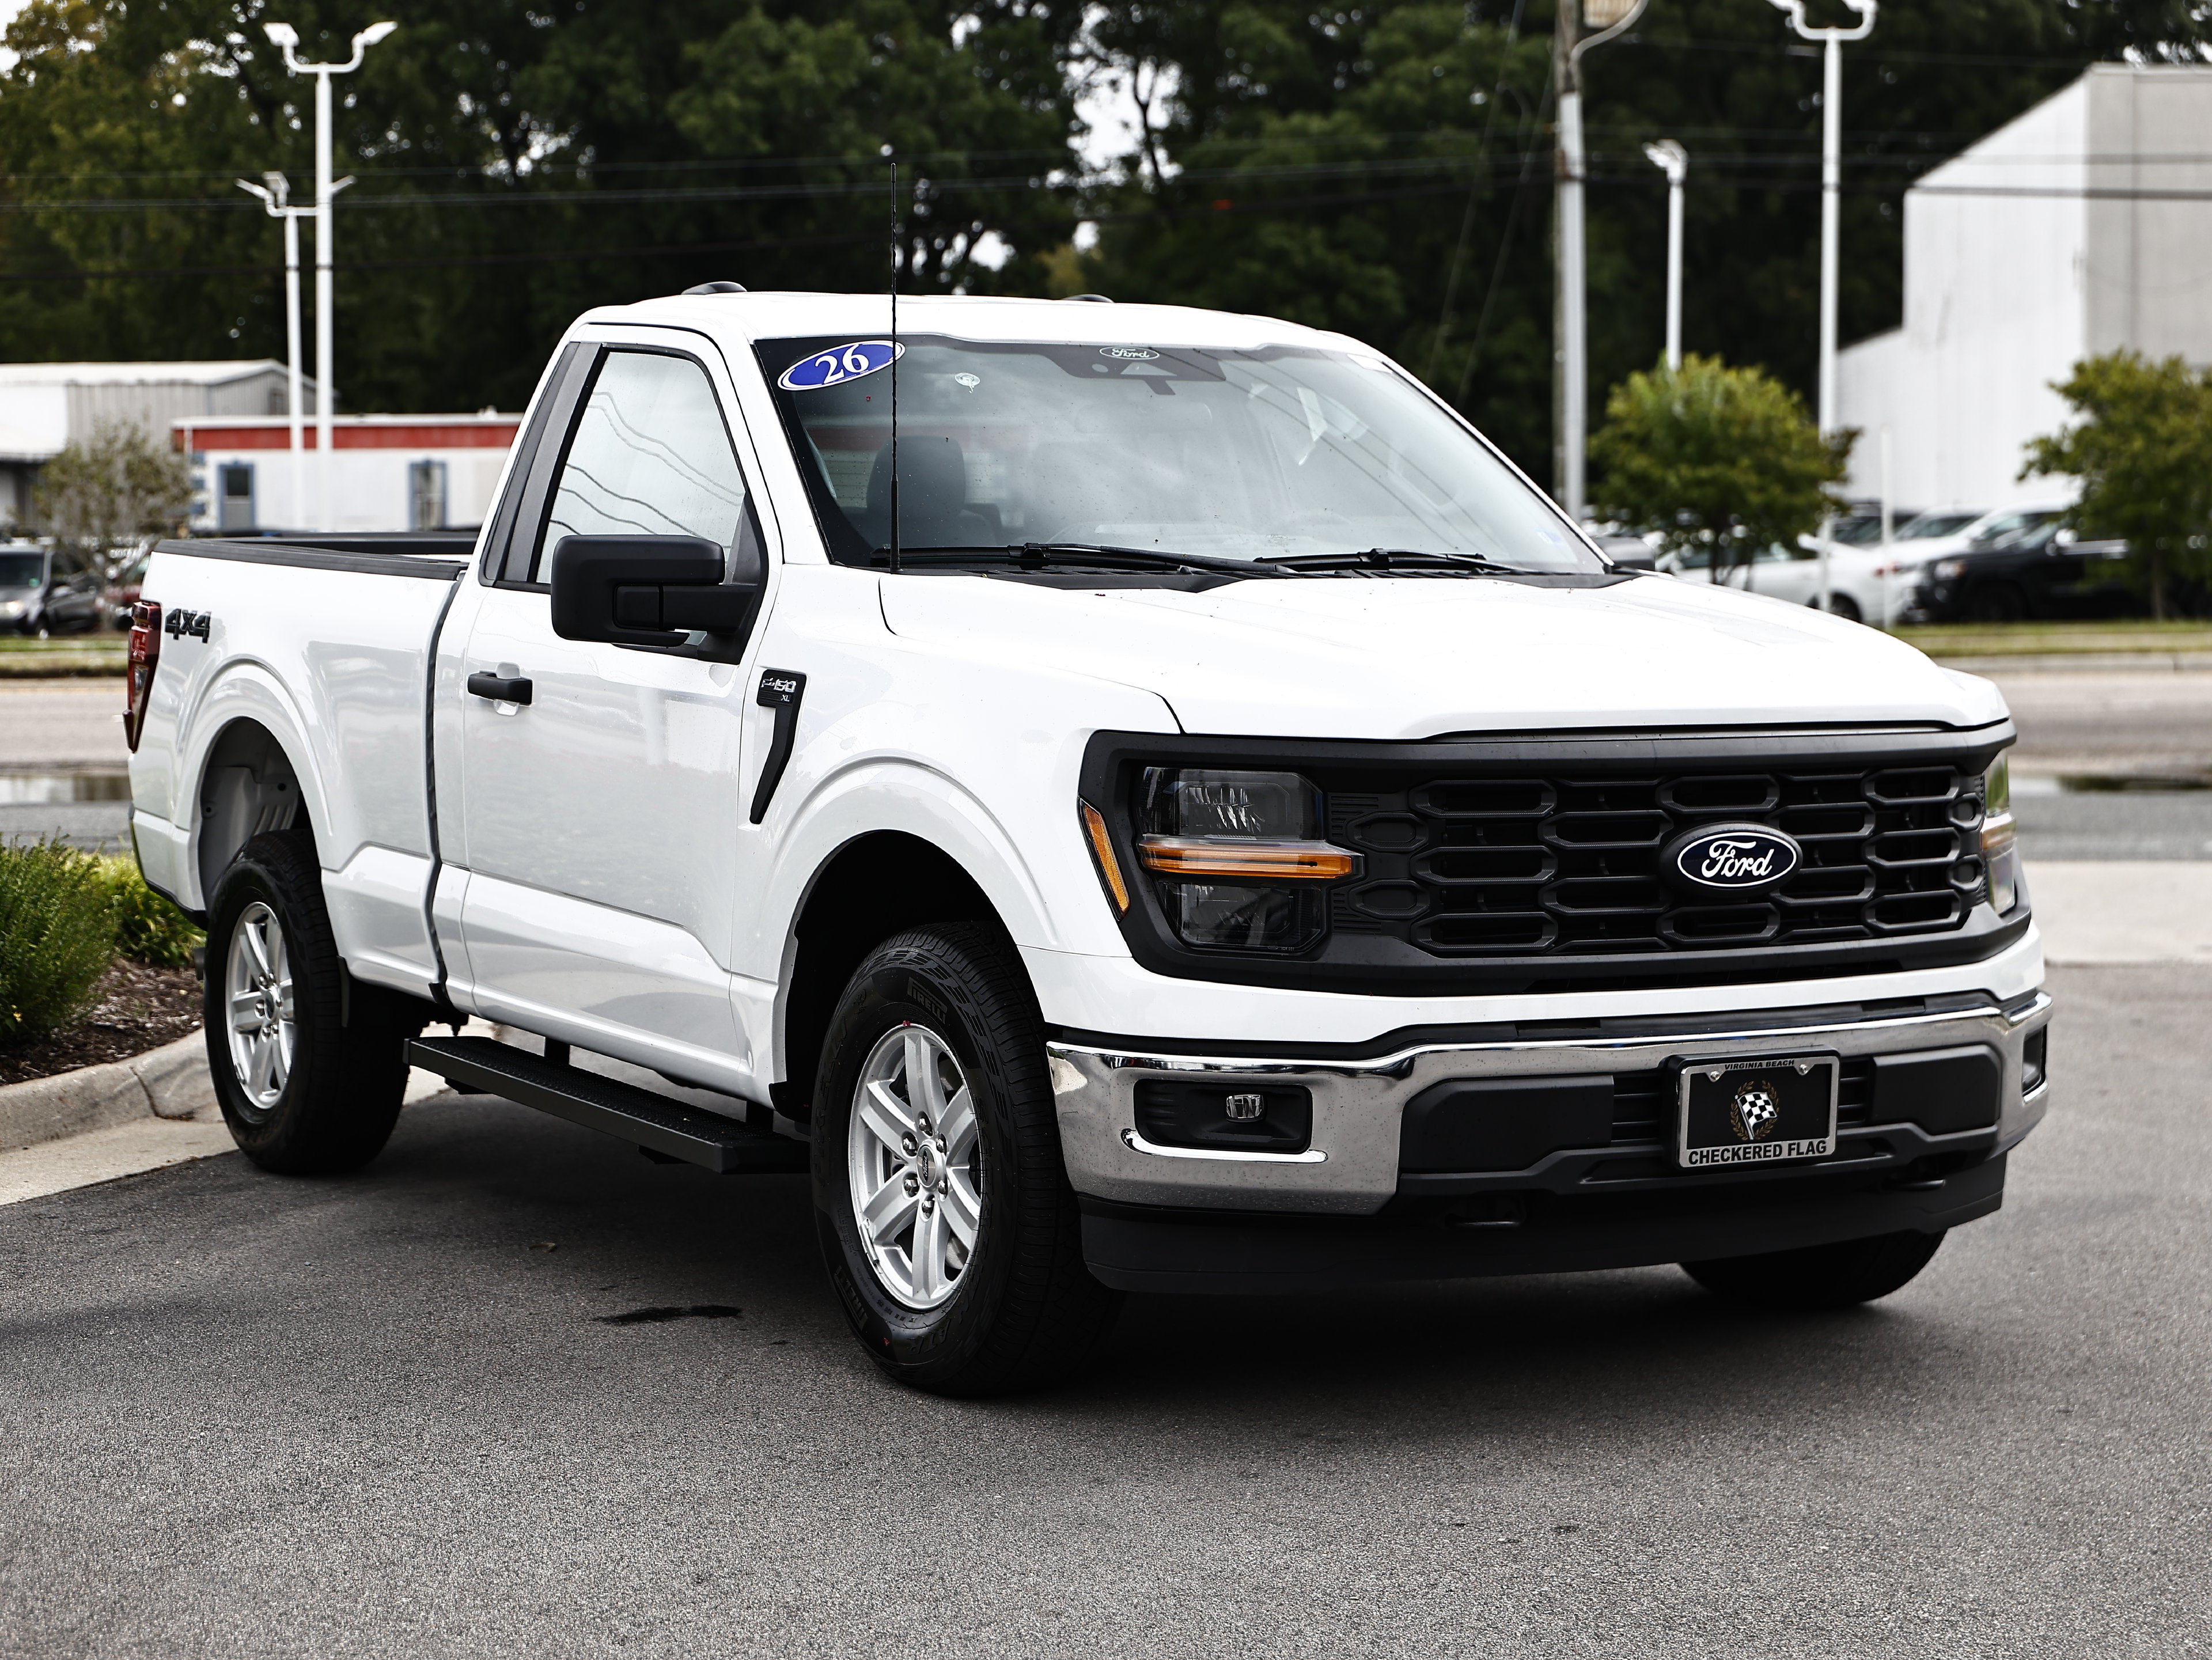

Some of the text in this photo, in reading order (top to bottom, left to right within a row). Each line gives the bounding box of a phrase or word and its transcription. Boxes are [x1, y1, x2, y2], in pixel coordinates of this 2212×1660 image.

[1112, 348, 1150, 358] Ford
[815, 344, 869, 384] 26
[760, 677, 797, 692] F-150
[781, 694, 790, 702] XL
[1701, 840, 1775, 878] Ford
[906, 977, 948, 1024] PIRELLI
[1725, 1059, 1794, 1070] VIRGINIA BEACH
[1688, 1140, 1826, 1165] CHECKERED FLAG
